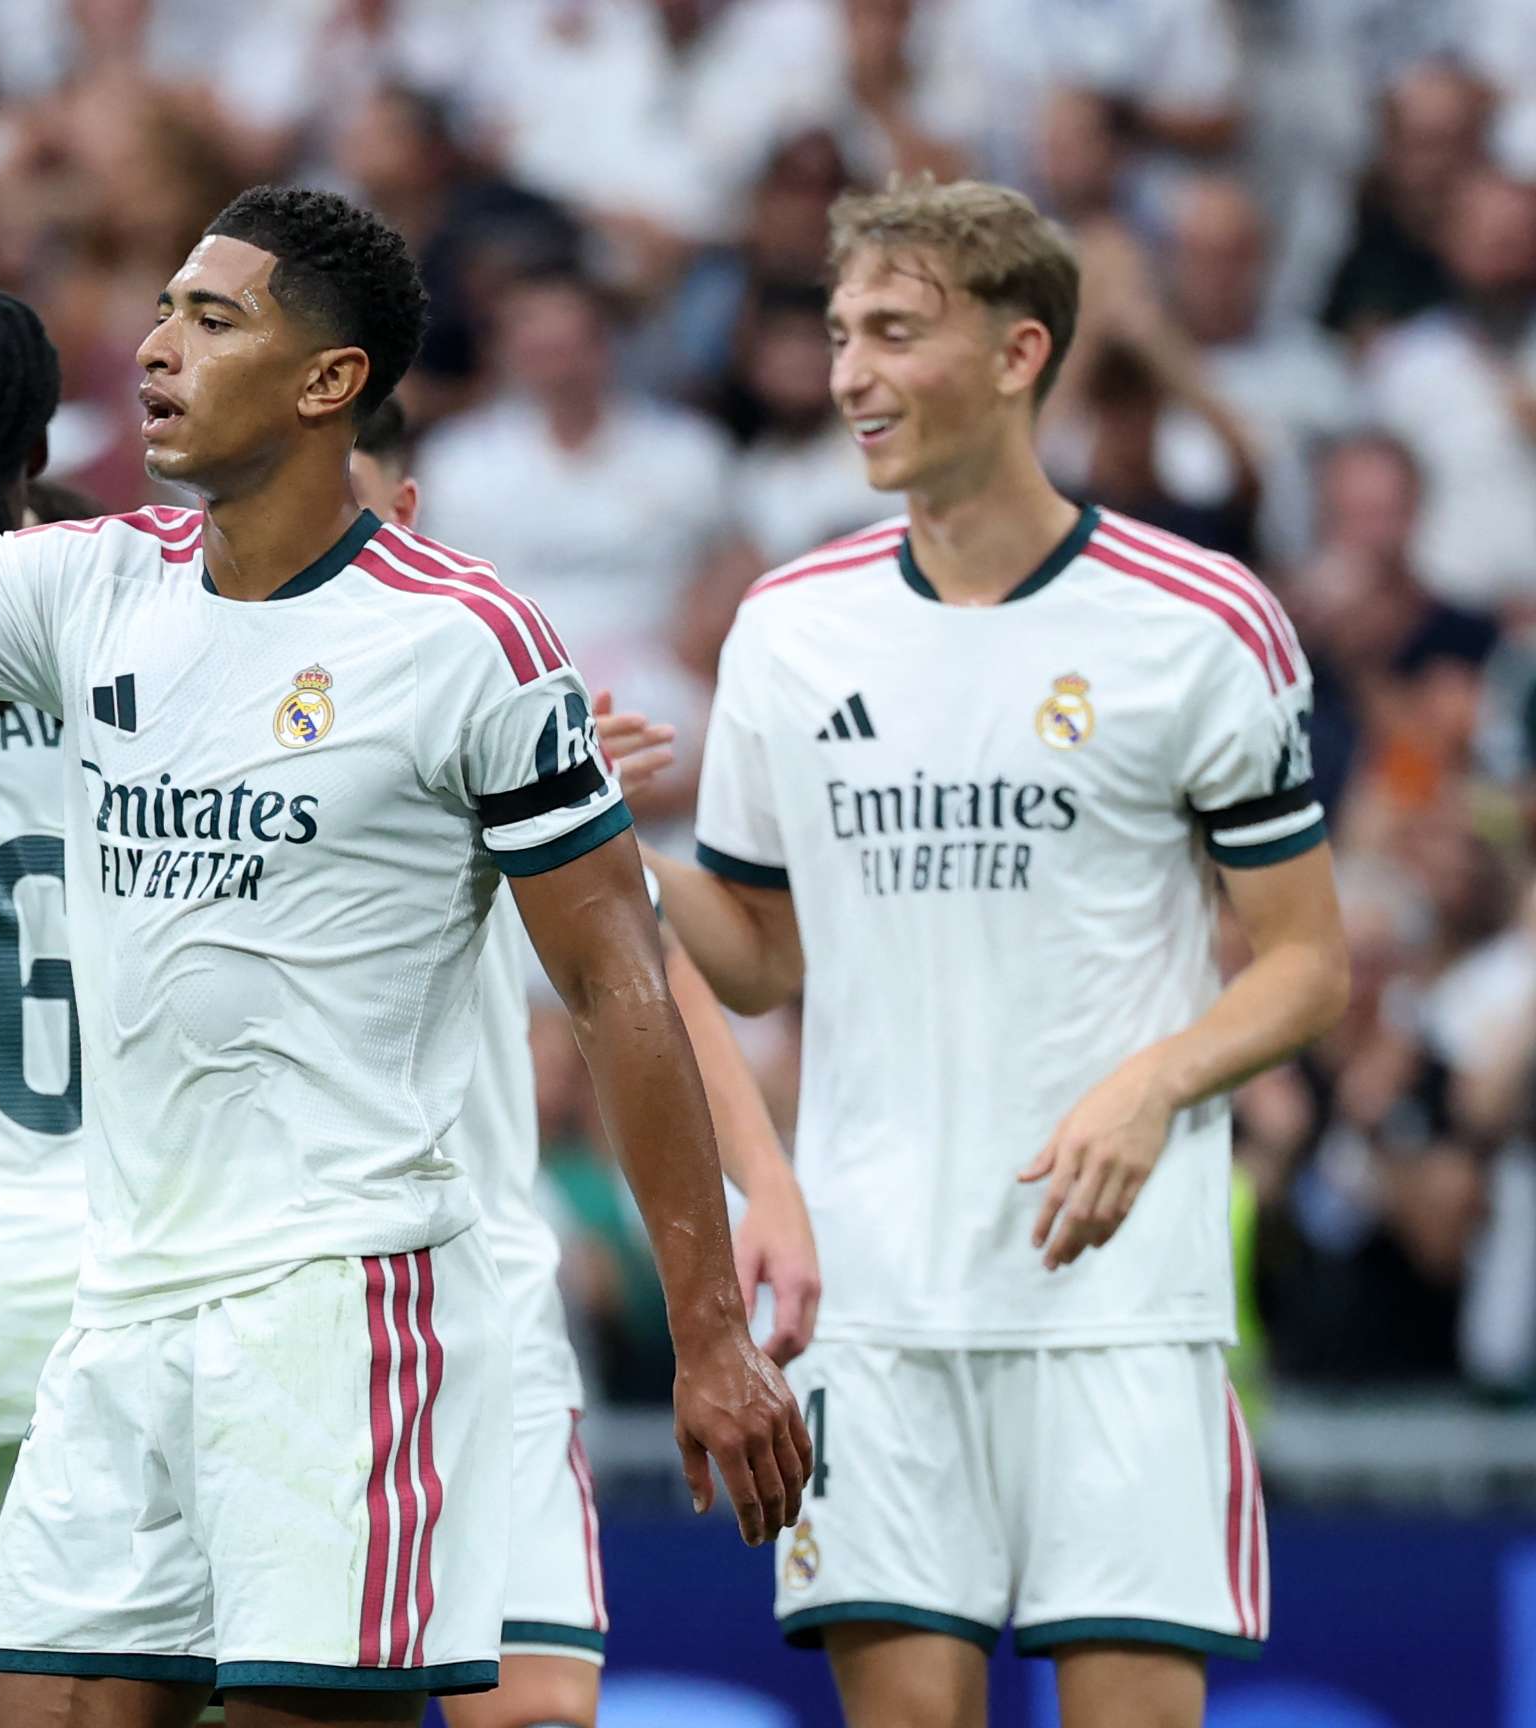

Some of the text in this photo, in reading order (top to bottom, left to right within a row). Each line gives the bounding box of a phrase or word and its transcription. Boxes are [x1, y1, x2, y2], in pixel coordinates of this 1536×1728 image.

[81, 759, 319, 844] mirates
[827, 770, 1078, 839] Emirates
[100, 844, 264, 900] FLY BETTER
